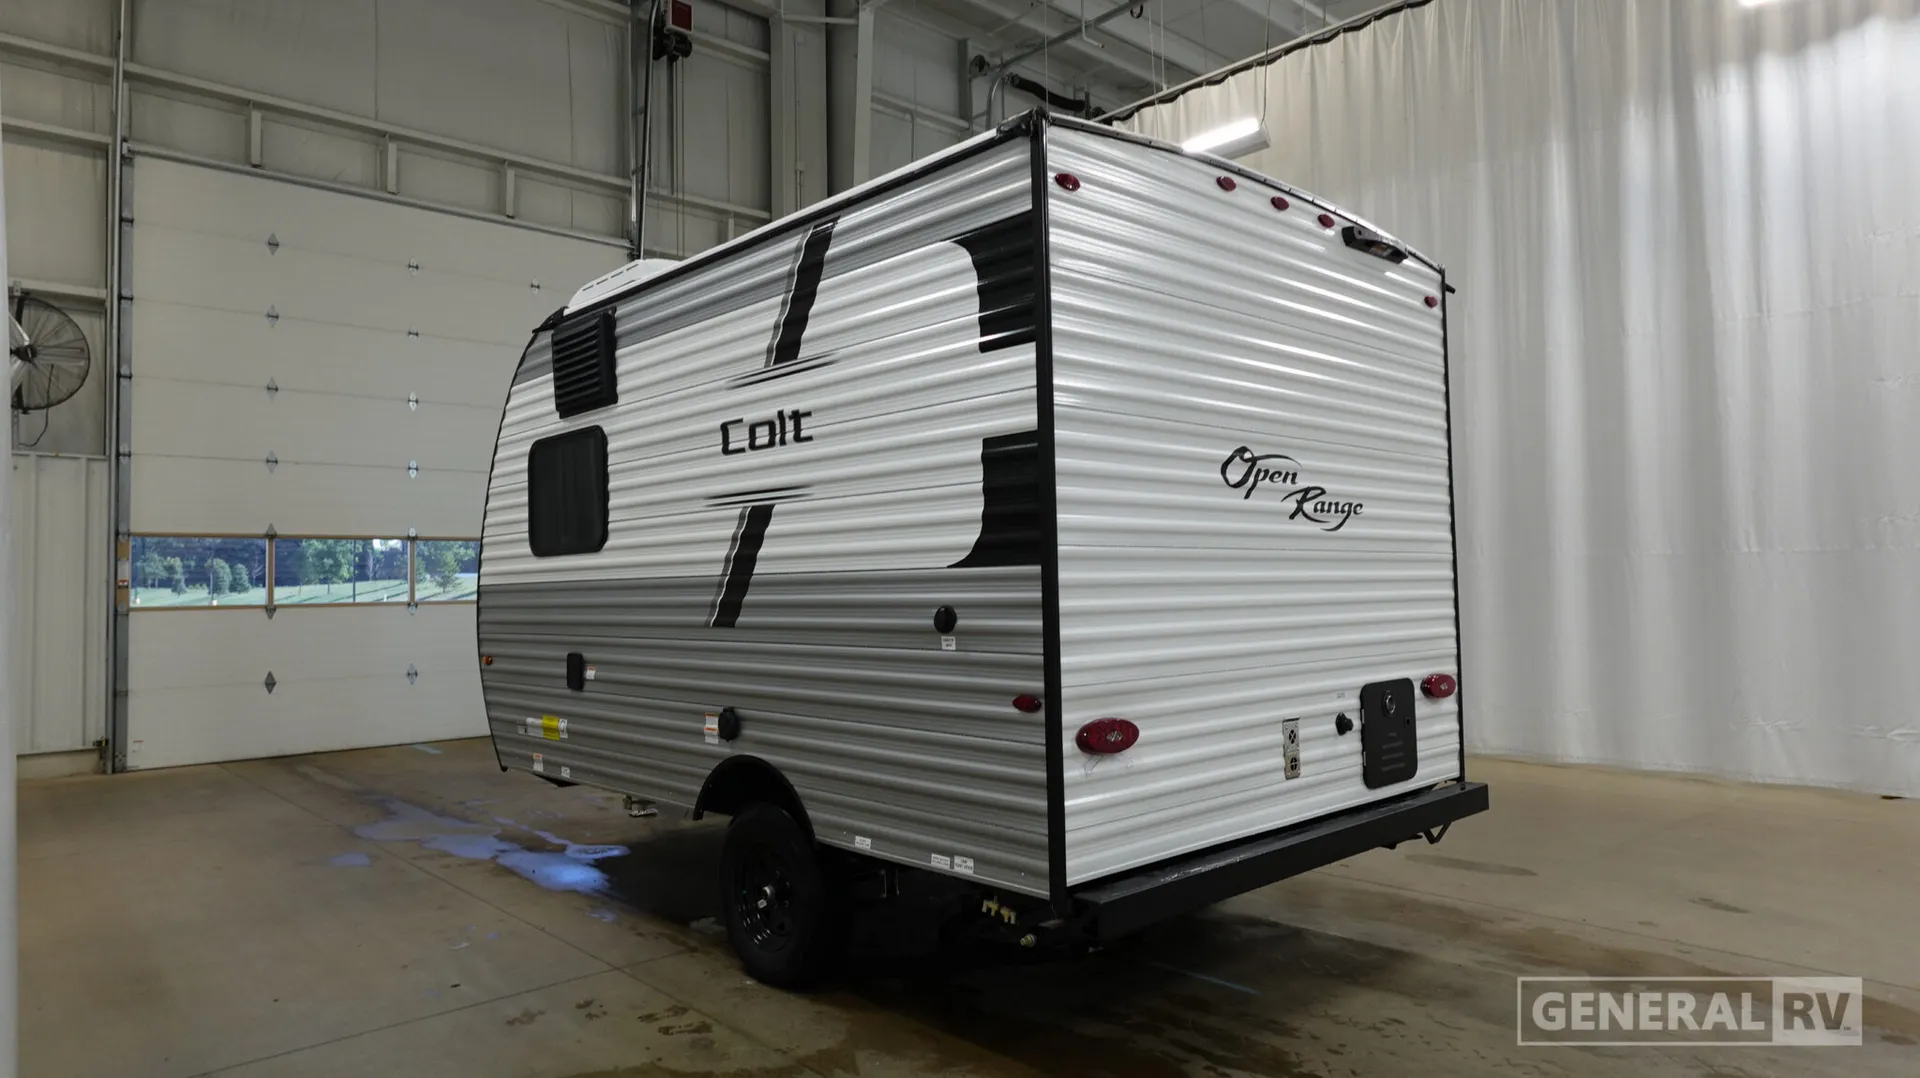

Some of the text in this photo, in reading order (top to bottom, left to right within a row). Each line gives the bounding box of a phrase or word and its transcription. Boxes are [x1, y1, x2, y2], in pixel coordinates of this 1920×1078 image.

[720, 409, 813, 456] Colt
[1220, 445, 1303, 499] Open
[1280, 486, 1364, 532] Range
